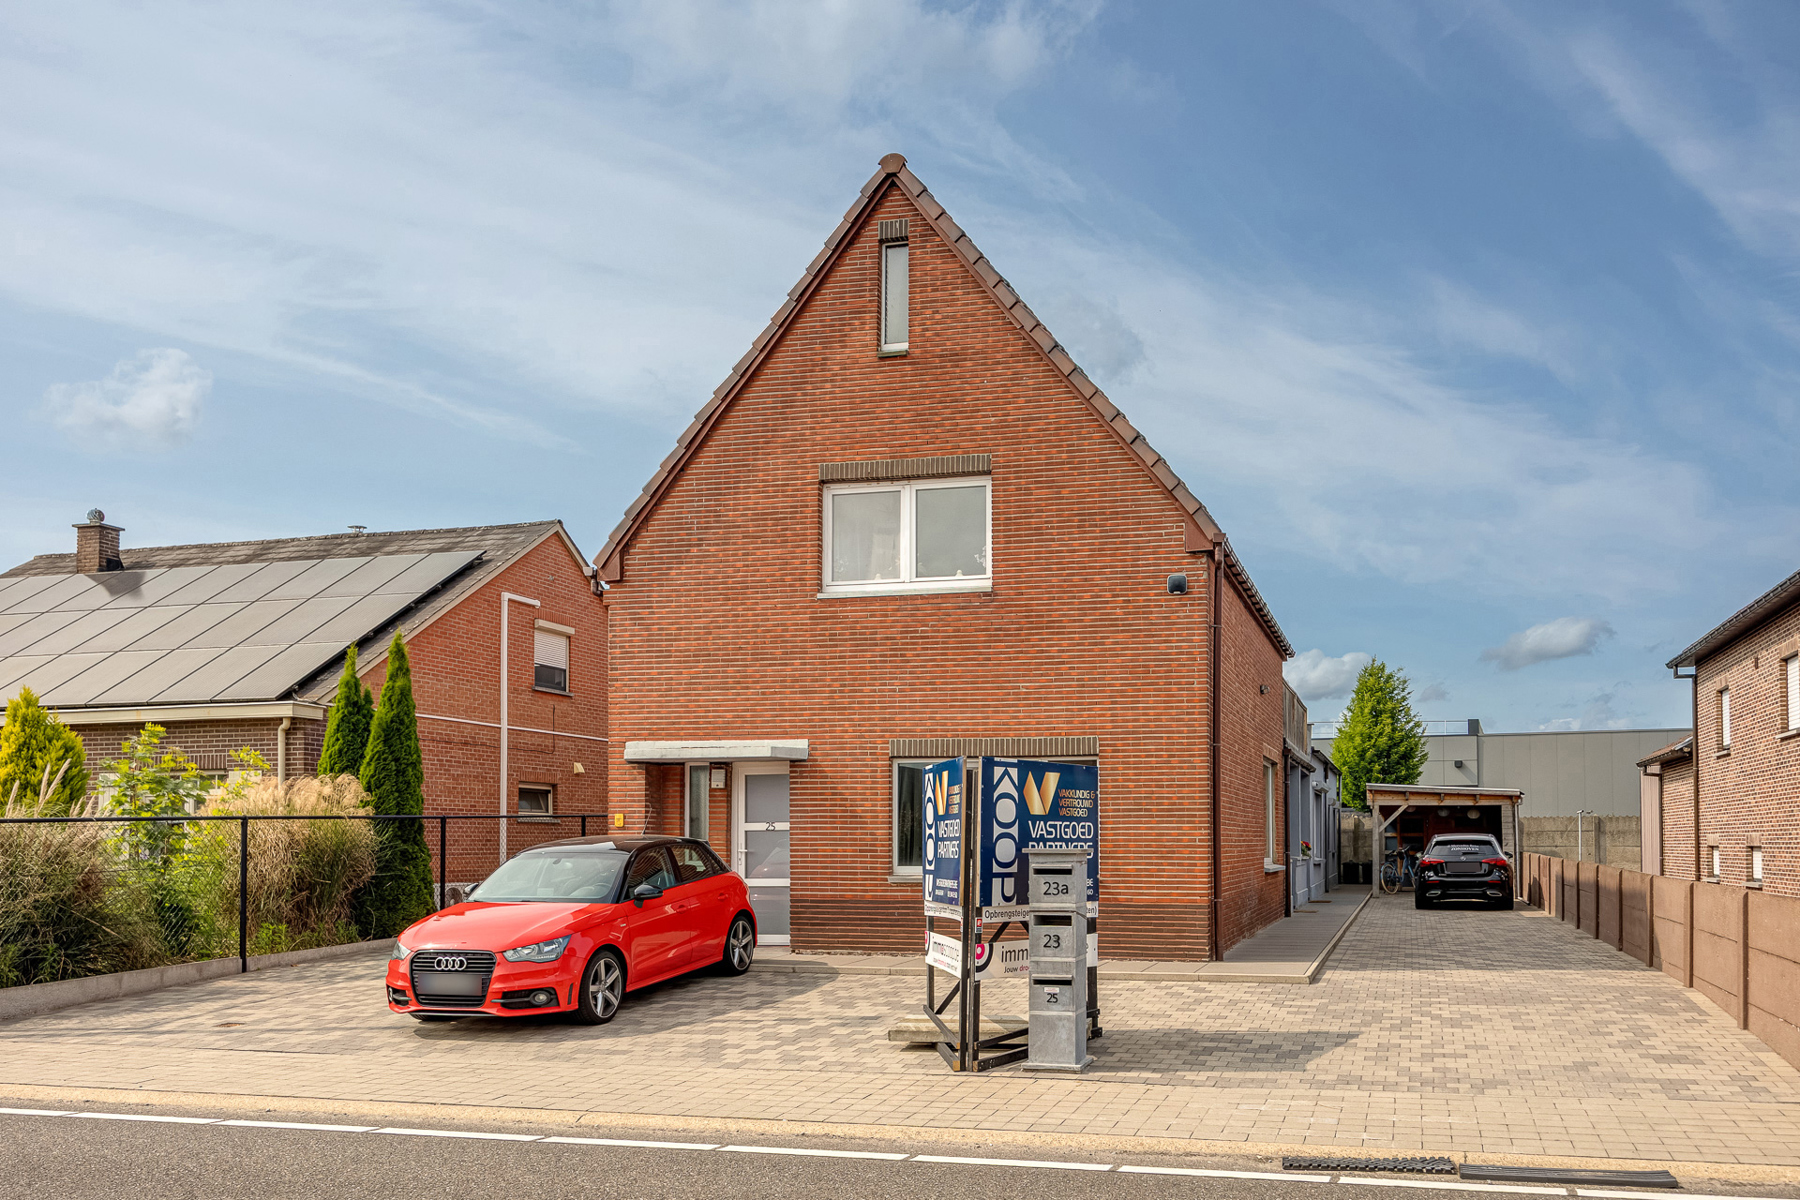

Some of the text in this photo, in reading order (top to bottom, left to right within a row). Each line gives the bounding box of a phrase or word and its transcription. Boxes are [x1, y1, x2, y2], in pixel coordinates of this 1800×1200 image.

[1058, 789, 1090, 799] VAKKUNDIG
[1058, 798, 1094, 808] VERTROUWD
[1058, 807, 1088, 817] VASTGOED
[766, 821, 776, 832] 25
[1028, 820, 1094, 839] VASTGOED
[925, 772, 935, 901] KOOP
[992, 766, 1018, 905] KOOP
[1043, 881, 1069, 896] 23a
[1043, 933, 1061, 949] 23
[1004, 966, 1018, 974] Jouw
[1046, 993, 1059, 1004] 25
